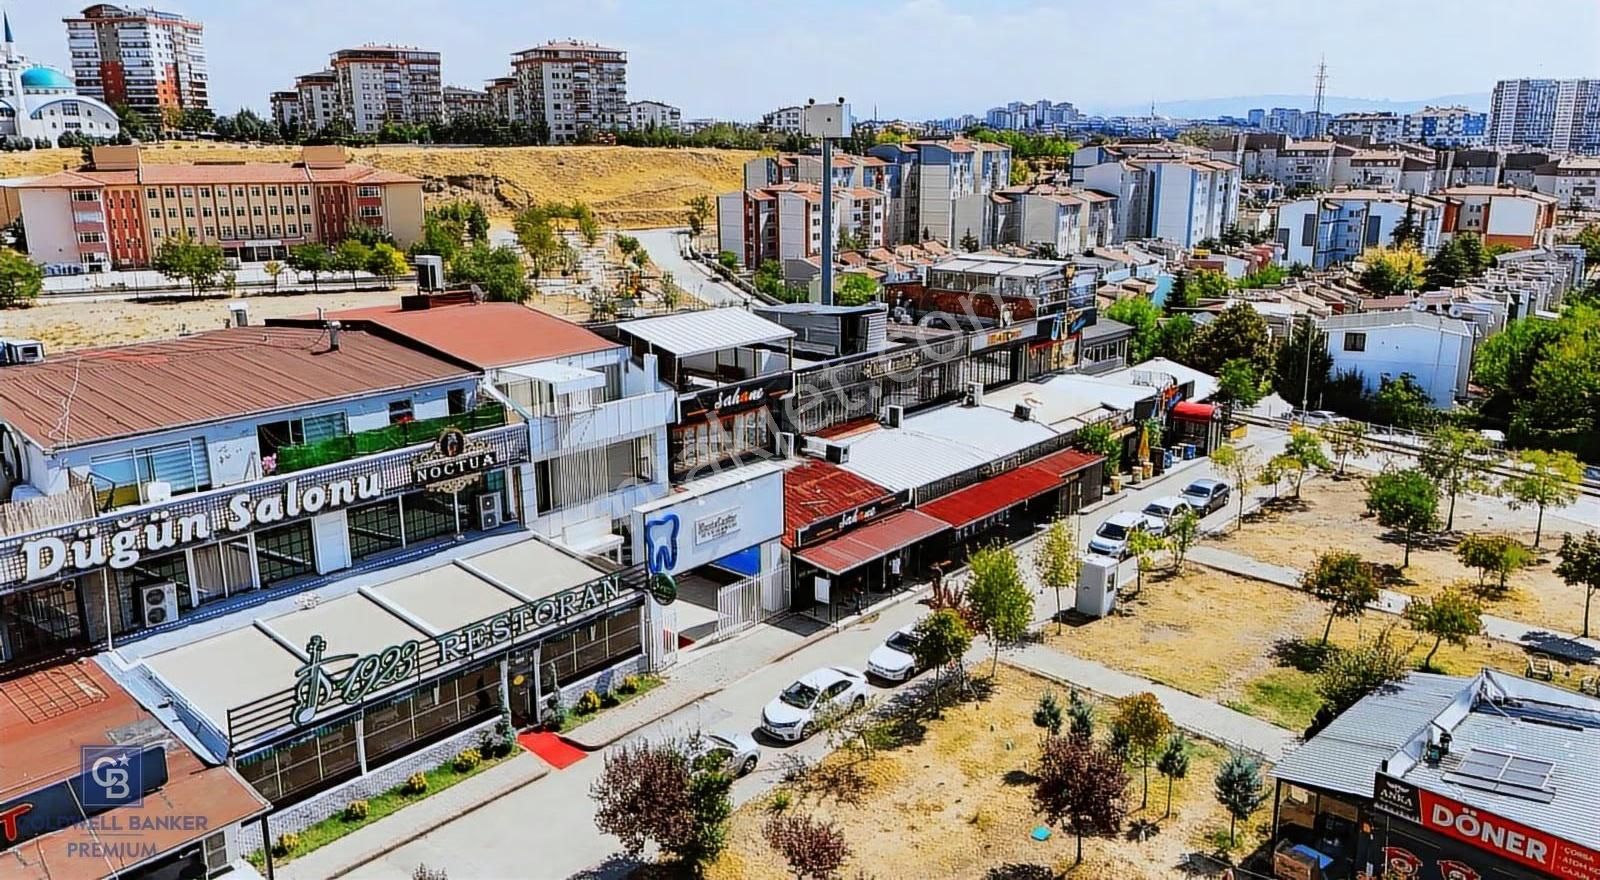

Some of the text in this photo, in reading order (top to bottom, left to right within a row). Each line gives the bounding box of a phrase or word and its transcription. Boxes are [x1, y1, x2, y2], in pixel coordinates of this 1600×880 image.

[417, 454, 494, 482] NOCTUA
[22, 510, 210, 583] Düğün
[227, 471, 383, 532] Salonu
[338, 640, 420, 704] 1923
[439, 574, 622, 665] RESTORAN
[1380, 788, 1413, 807] ANKA
[1432, 804, 1548, 864] DÖNER
